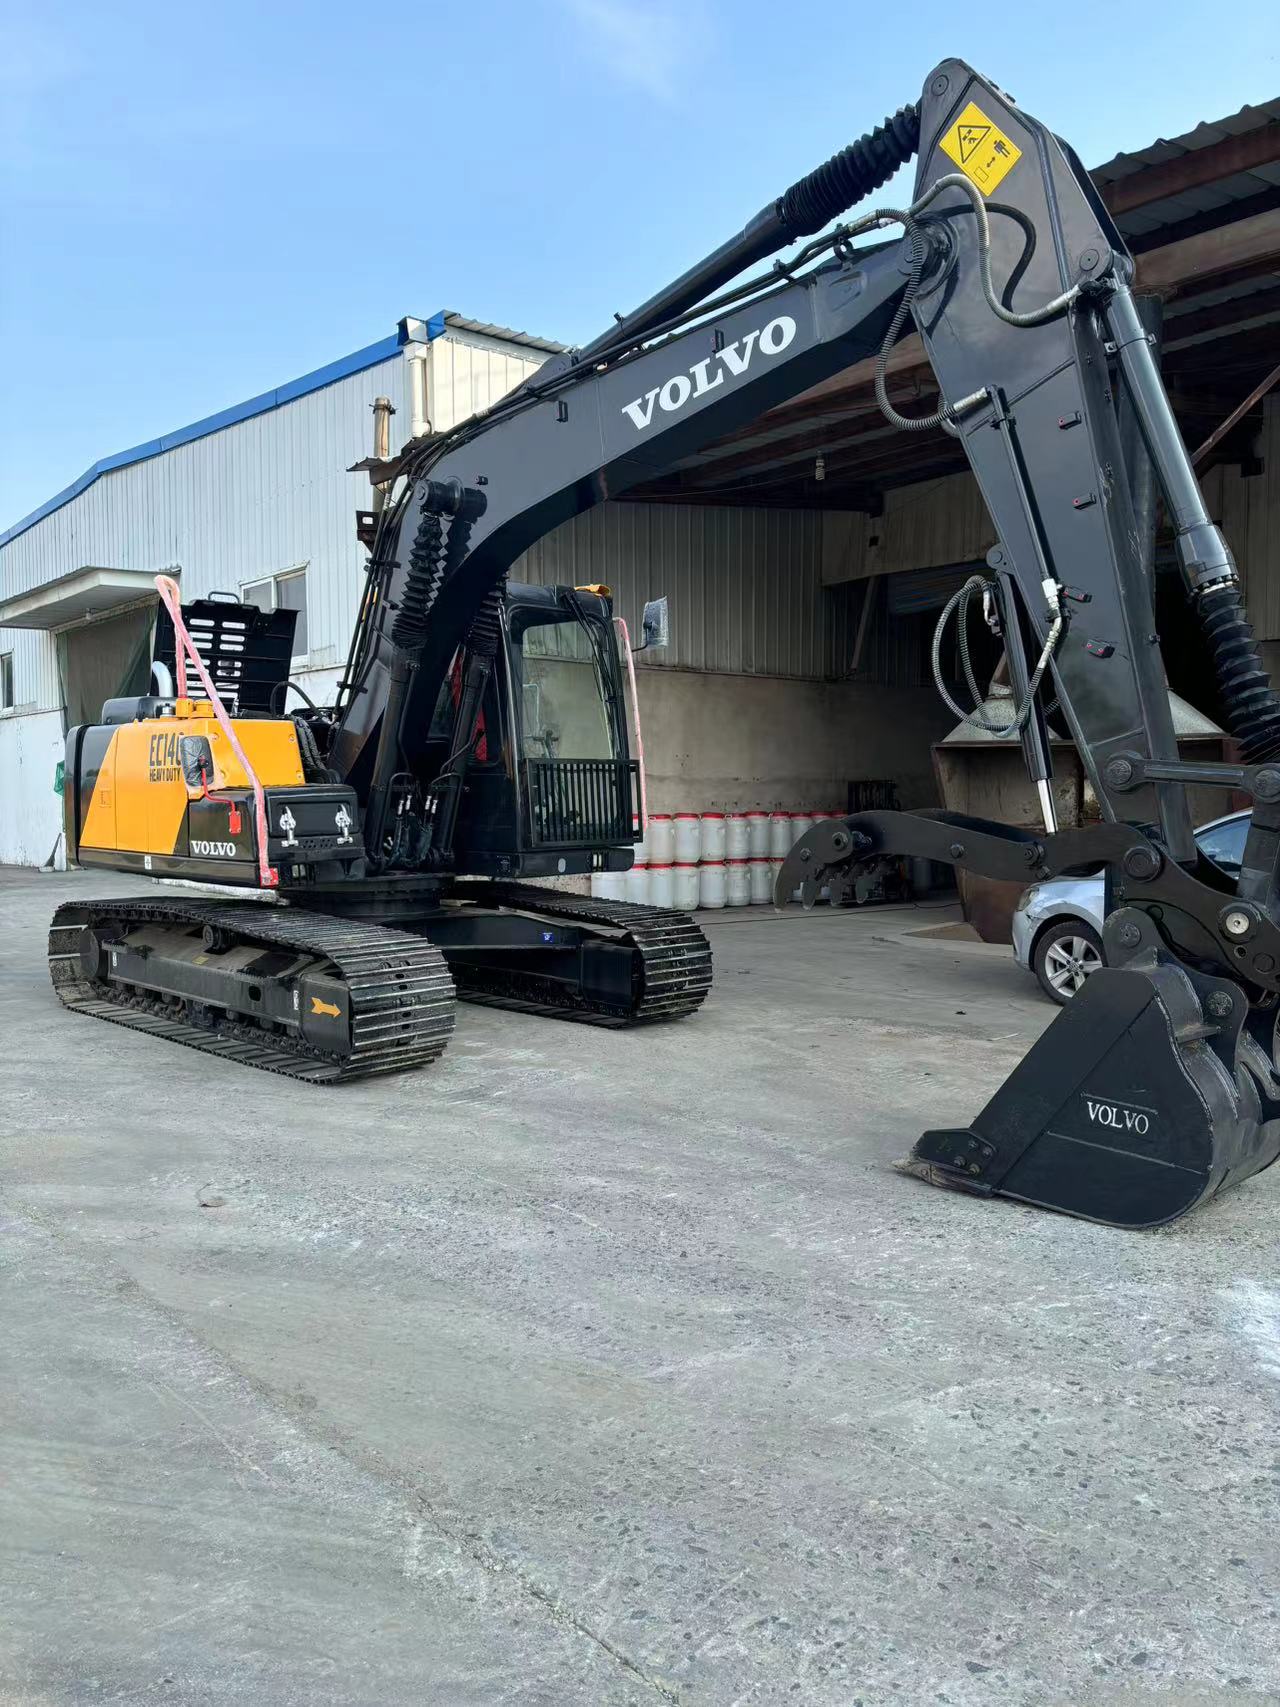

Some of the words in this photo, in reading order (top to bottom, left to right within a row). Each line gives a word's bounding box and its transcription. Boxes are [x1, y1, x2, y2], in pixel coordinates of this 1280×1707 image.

[621, 316, 797, 430] VOLVO
[191, 840, 236, 857] VOLVO
[1087, 1101, 1149, 1134] VOLVO
